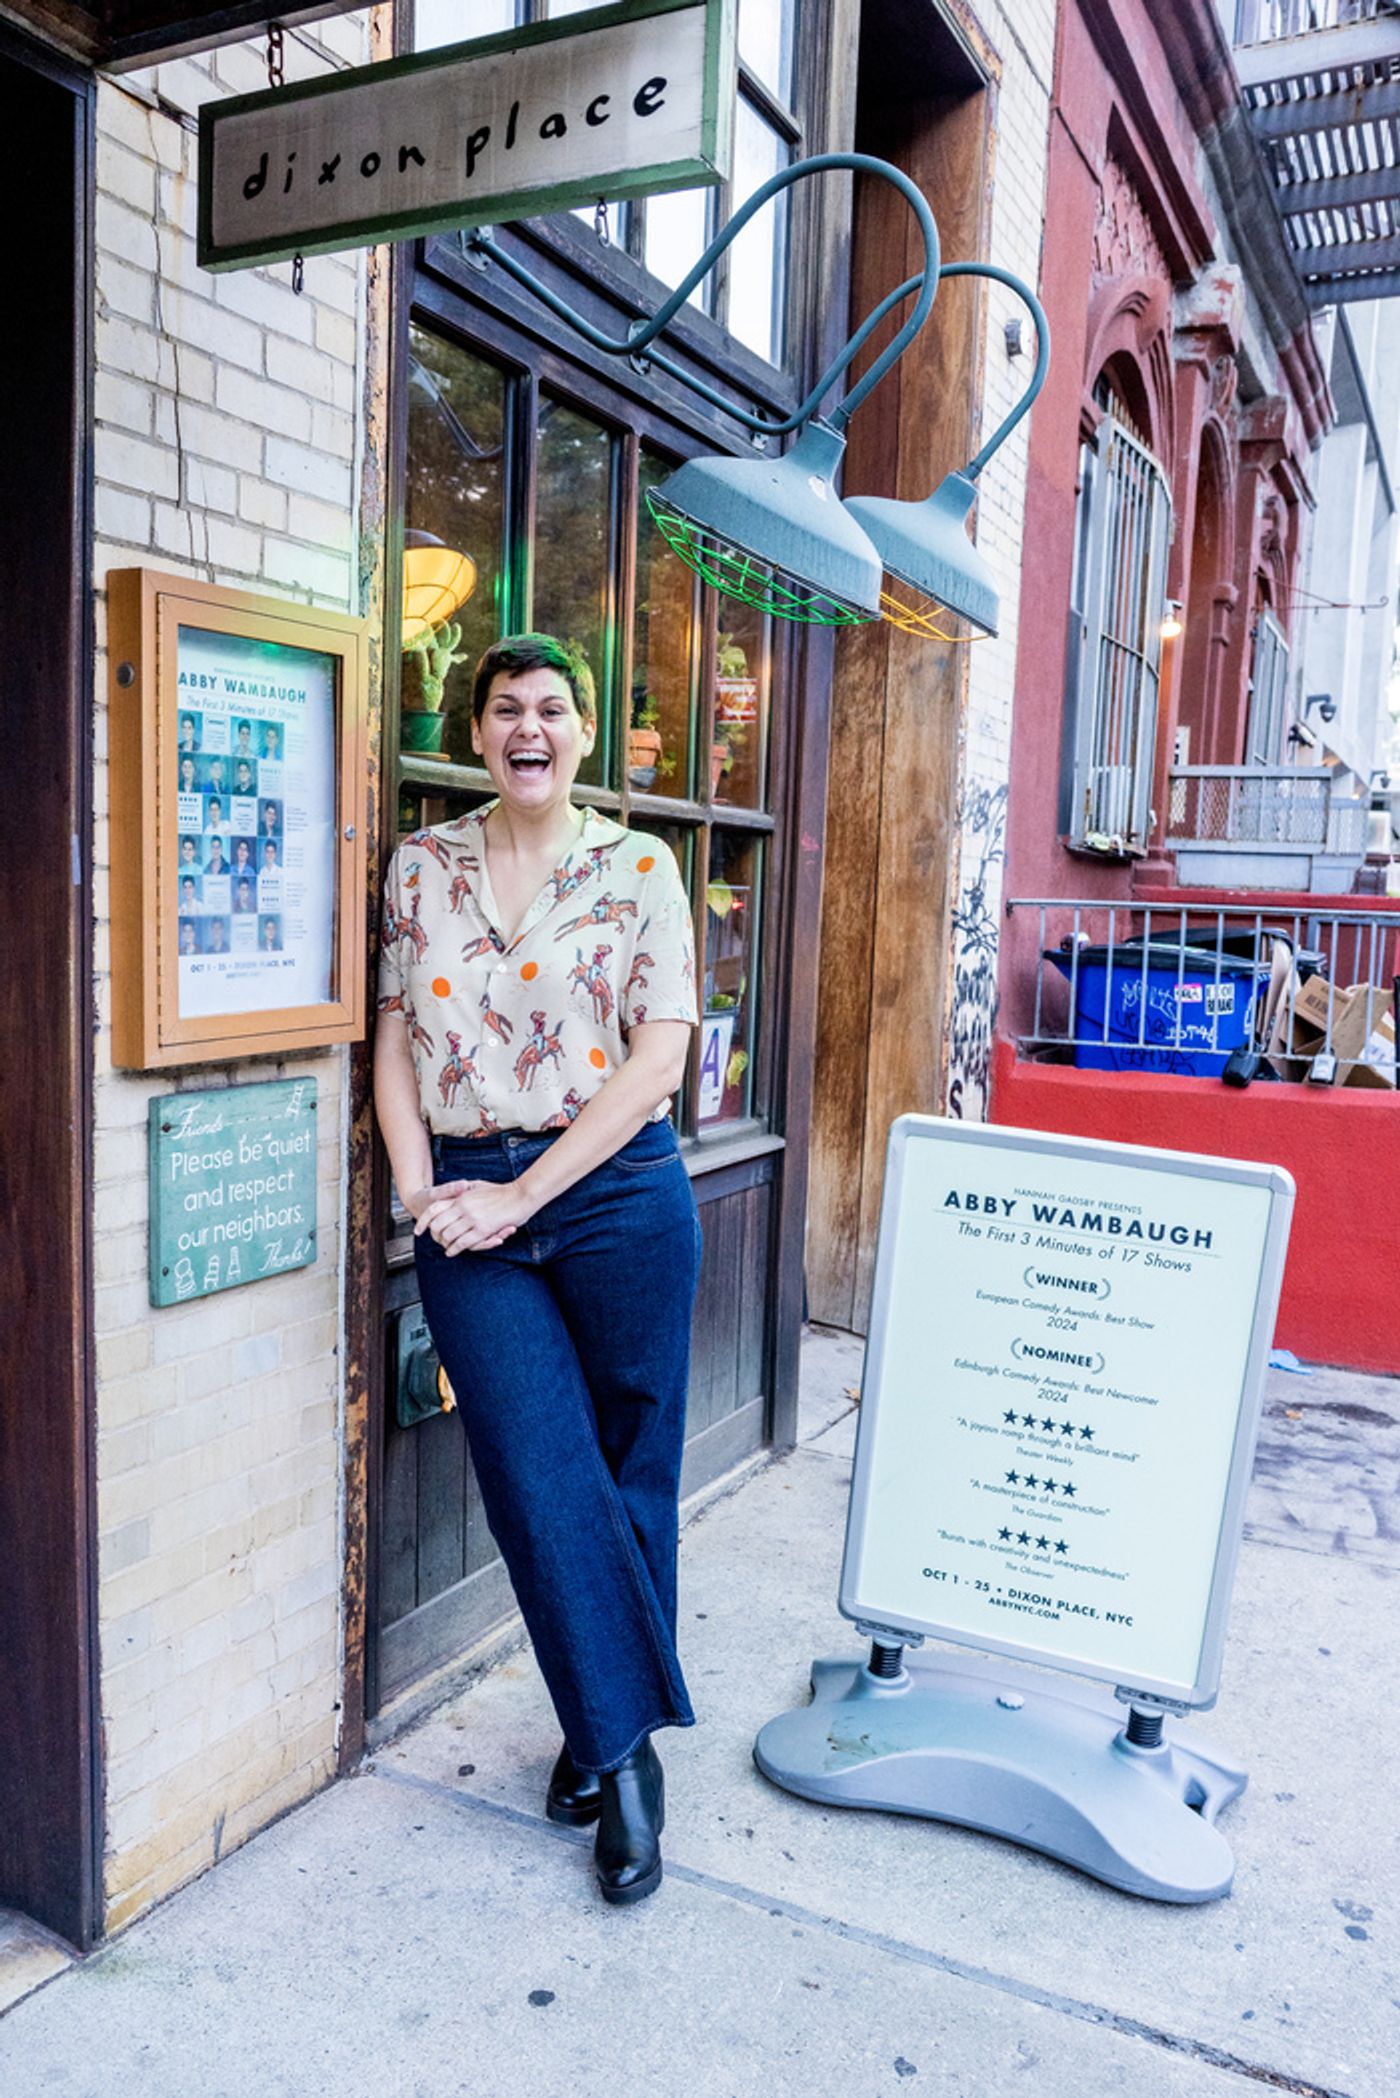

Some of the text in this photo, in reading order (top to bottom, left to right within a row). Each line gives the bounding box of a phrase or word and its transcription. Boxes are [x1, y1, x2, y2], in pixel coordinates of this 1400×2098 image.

[243, 76, 668, 200] dixon place
[177, 672, 217, 690] ABBY
[224, 678, 306, 704] WAMBAUGH
[171, 1128, 312, 1181] Please be quiet
[184, 1168, 296, 1212] and respect
[1014, 1187, 1143, 1215] HANNAH GADSBY PRESENTS
[178, 1204, 305, 1251] our neighbors.
[943, 1189, 1214, 1249] ABBY WAMBAUGH
[957, 1221, 1193, 1273] The First 3 Minutes of 17 Shows
[975, 1289, 1019, 1307] European
[1022, 1297, 1061, 1315] Comedy
[1104, 1313, 1126, 1326] Best
[1127, 1317, 1155, 1331] Show
[1046, 1316, 1078, 1332] 2024
[954, 1358, 999, 1376] Edinburgh
[1002, 1367, 1041, 1386] Comedy
[1083, 1383, 1105, 1396] Best
[1106, 1387, 1159, 1407] Newcomer
[1037, 1387, 1069, 1404] 2024
[969, 1421, 999, 1434] joyous
[1000, 1428, 1026, 1441] romp
[1027, 1432, 1062, 1449] through
[1064, 1442, 1073, 1450] a
[1074, 1441, 1110, 1458] brilliant
[982, 1484, 1037, 1503] masterpiece
[1038, 1494, 1051, 1505] of
[1026, 1507, 1063, 1523] Guardian
[968, 1537, 988, 1549] with
[989, 1543, 1030, 1561] creativity
[1032, 1551, 1052, 1564] and
[922, 1567, 947, 1582] OCT
[952, 1574, 959, 1585] 1
[974, 1579, 990, 1593] 25
[1007, 1588, 1052, 1608] DIXON
[1056, 1599, 1101, 1620] PLACE,
[1105, 1611, 1134, 1627] NYC
[988, 1596, 1061, 1621] ABBYNYC.COM
